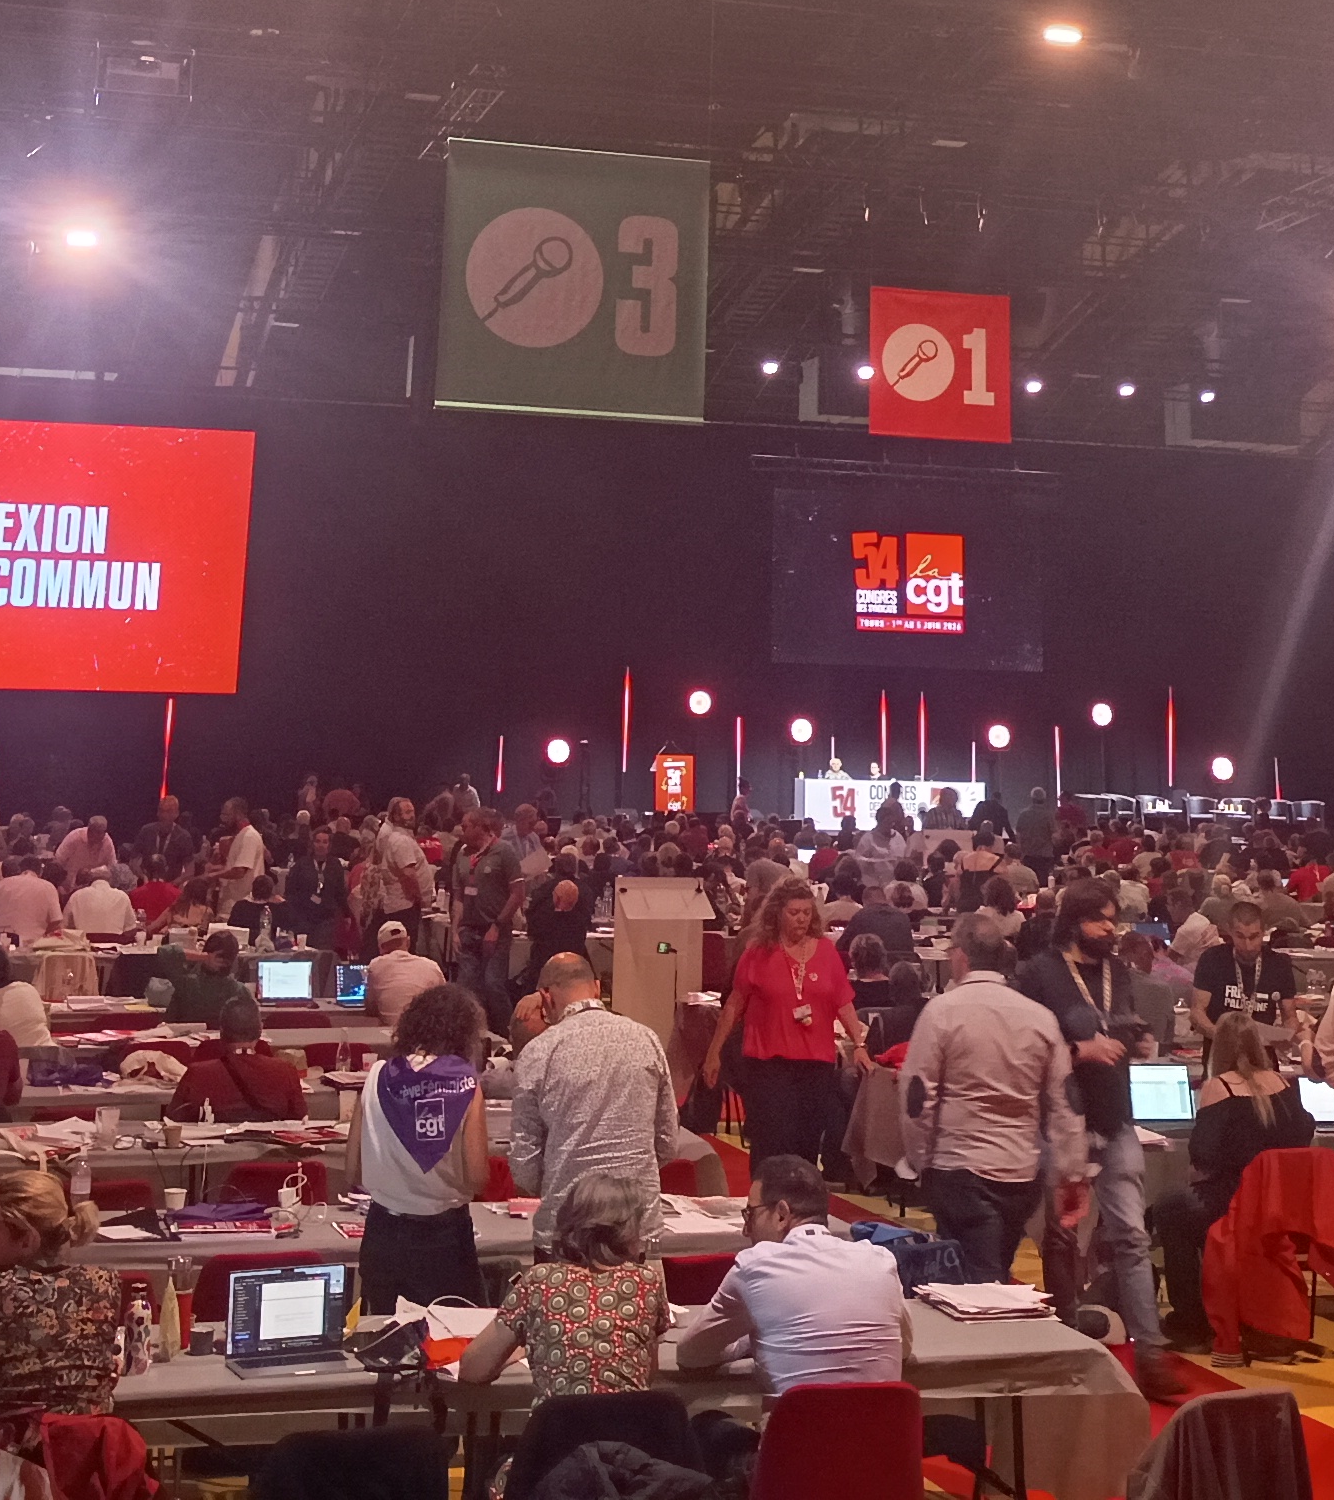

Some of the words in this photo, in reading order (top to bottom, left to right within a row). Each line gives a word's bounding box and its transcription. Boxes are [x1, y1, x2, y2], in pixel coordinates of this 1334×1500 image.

[614, 214, 679, 358] 3
[962, 327, 996, 407] 1
[851, 531, 899, 589] 54
[906, 572, 964, 613] cgt
[416, 1114, 445, 1137] cgt
